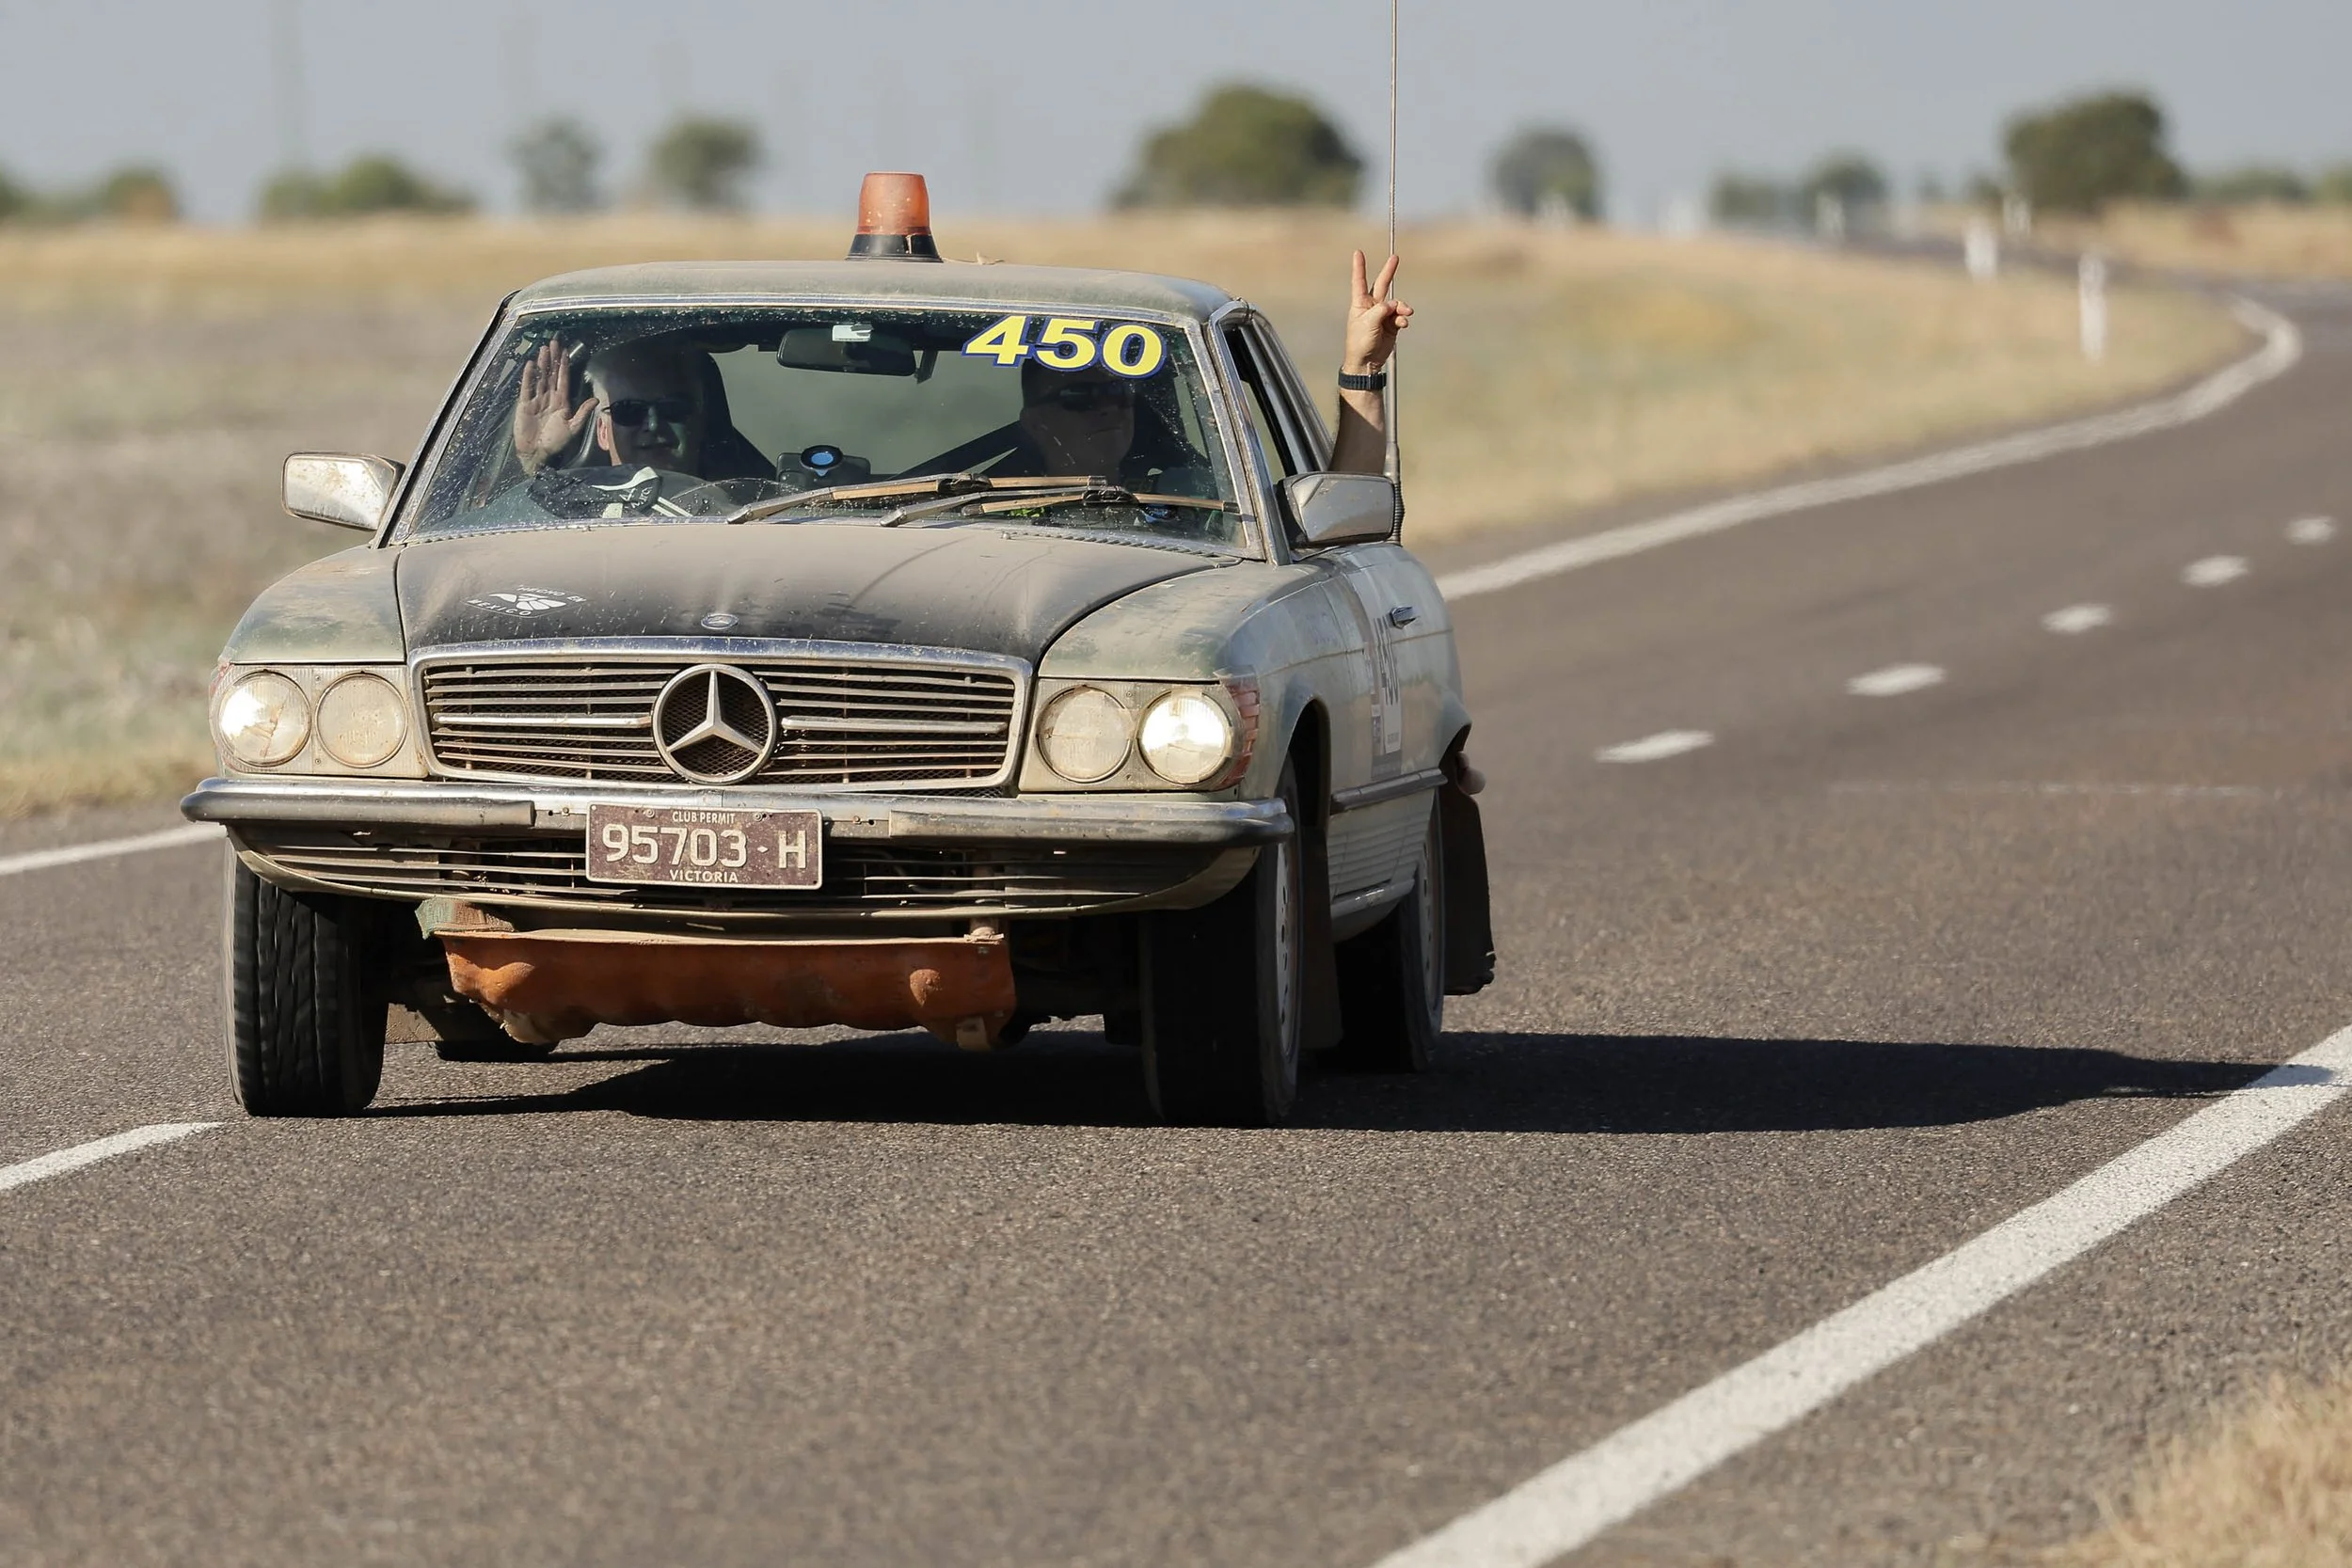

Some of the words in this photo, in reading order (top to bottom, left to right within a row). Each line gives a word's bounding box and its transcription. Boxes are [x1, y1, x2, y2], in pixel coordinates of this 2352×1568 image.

[961, 315, 1167, 378] 450
[467, 599, 532, 616] MEXICO
[672, 811, 698, 823] CLUB
[699, 812, 736, 824] PERMIT
[669, 869, 739, 883] VICTORIA
